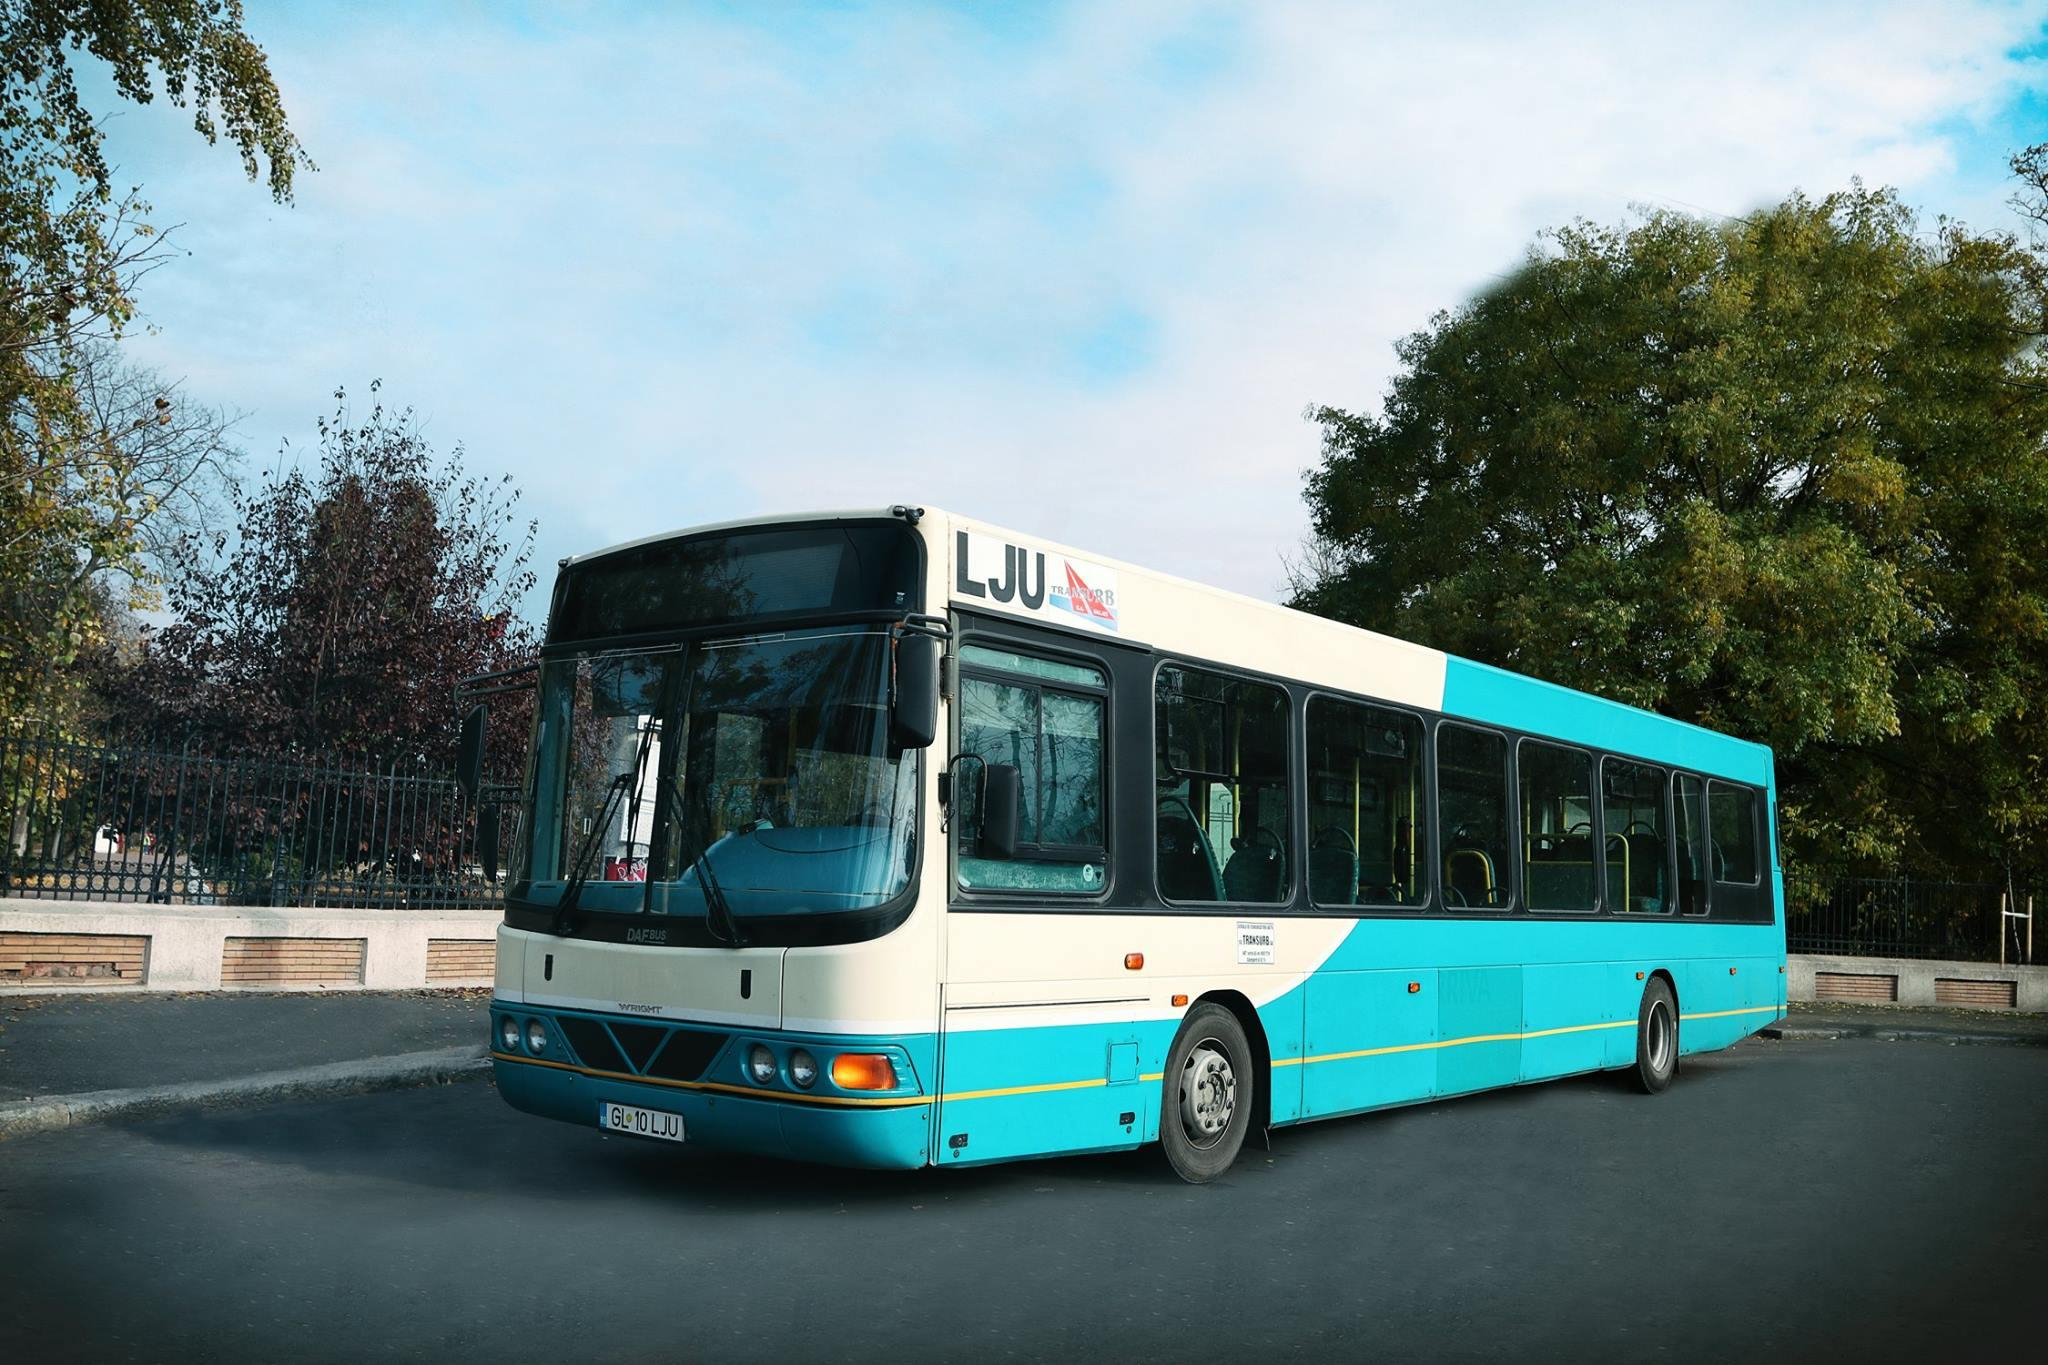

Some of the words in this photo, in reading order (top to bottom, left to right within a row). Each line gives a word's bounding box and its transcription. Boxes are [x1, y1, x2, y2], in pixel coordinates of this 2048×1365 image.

[957, 530, 1045, 610] LJU
[627, 928, 649, 942] DAF
[649, 929, 667, 940] BUS
[618, 1003, 663, 1014] WRIGHT
[611, 1107, 629, 1129] GL
[635, 1110, 648, 1132] 10
[651, 1112, 679, 1137] LJU
